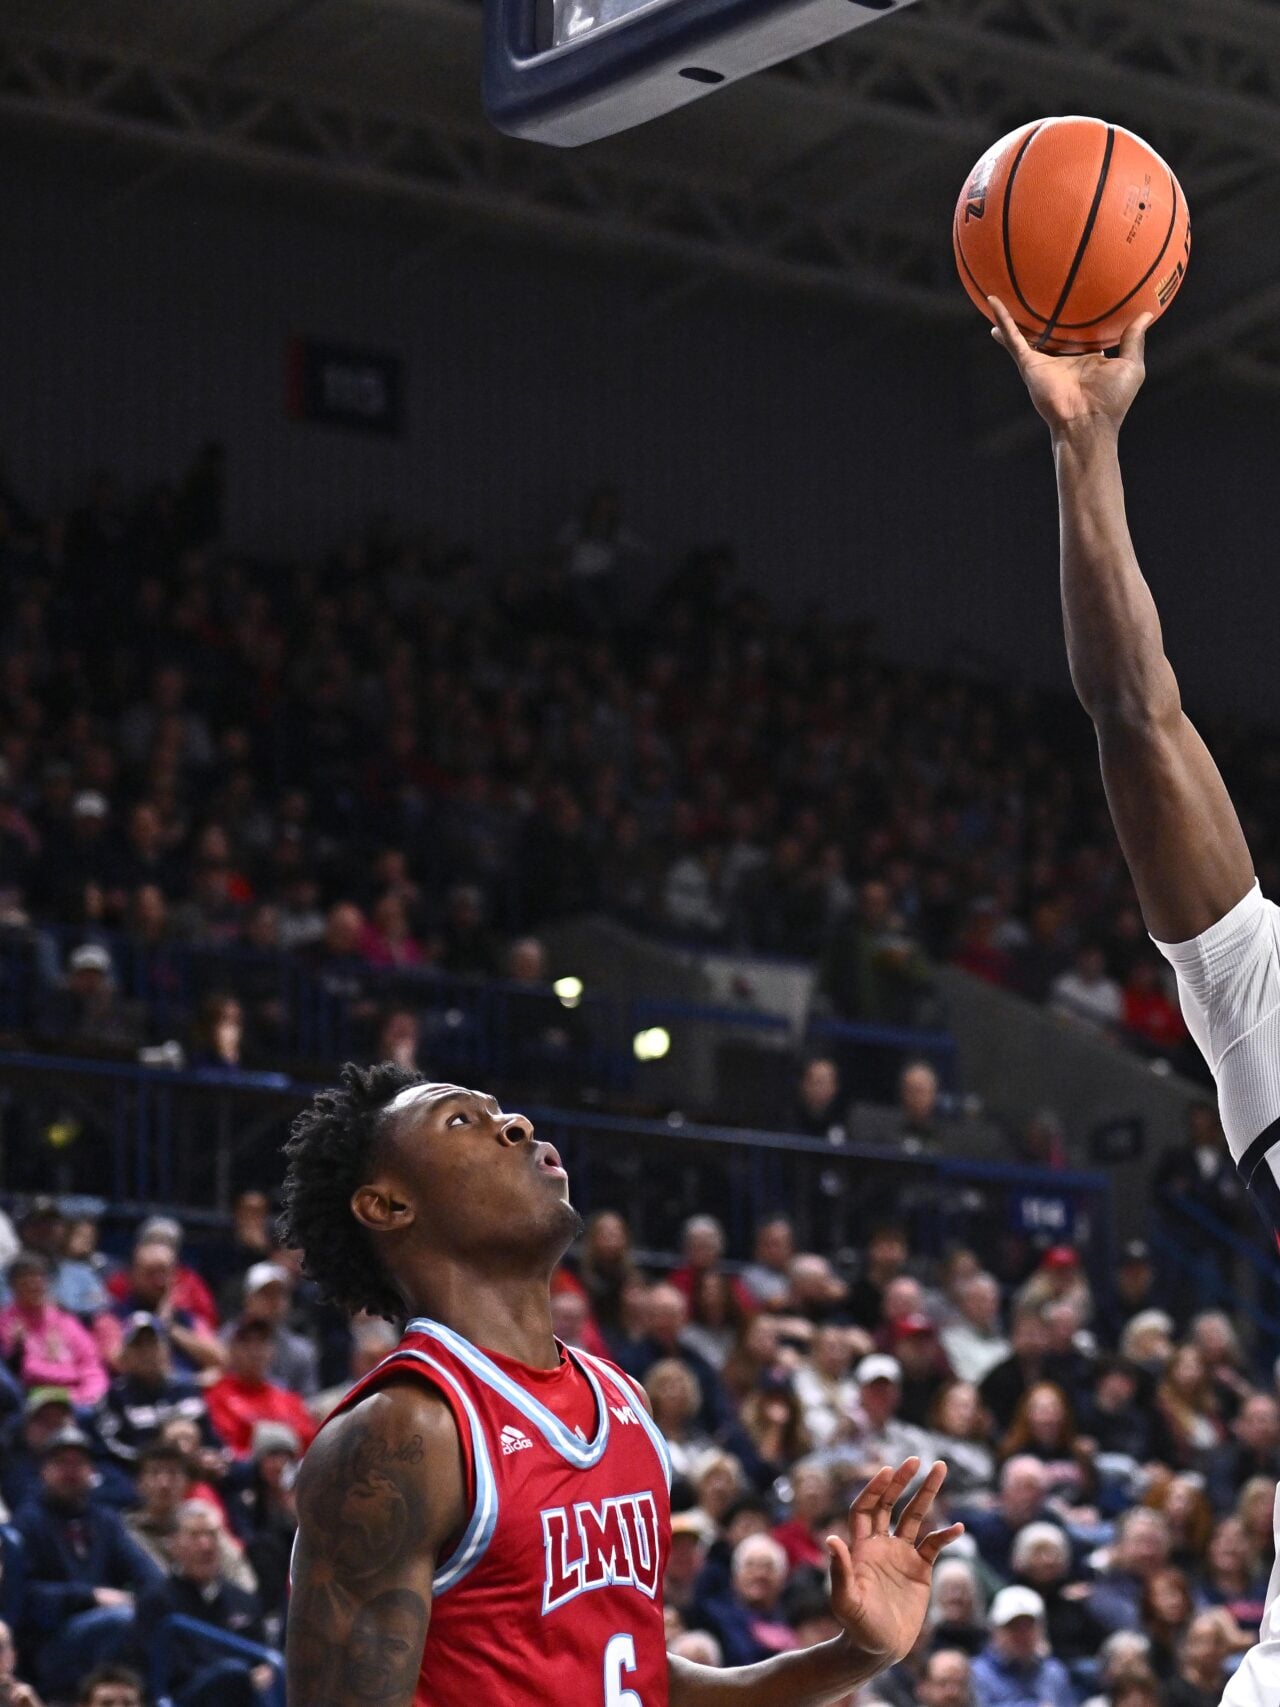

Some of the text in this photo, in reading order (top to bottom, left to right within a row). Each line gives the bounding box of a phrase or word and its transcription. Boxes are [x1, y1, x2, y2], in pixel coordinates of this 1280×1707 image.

[502, 1438, 534, 1456] adidas
[540, 1490, 660, 1617] LMU
[603, 1632, 644, 1707] 6
